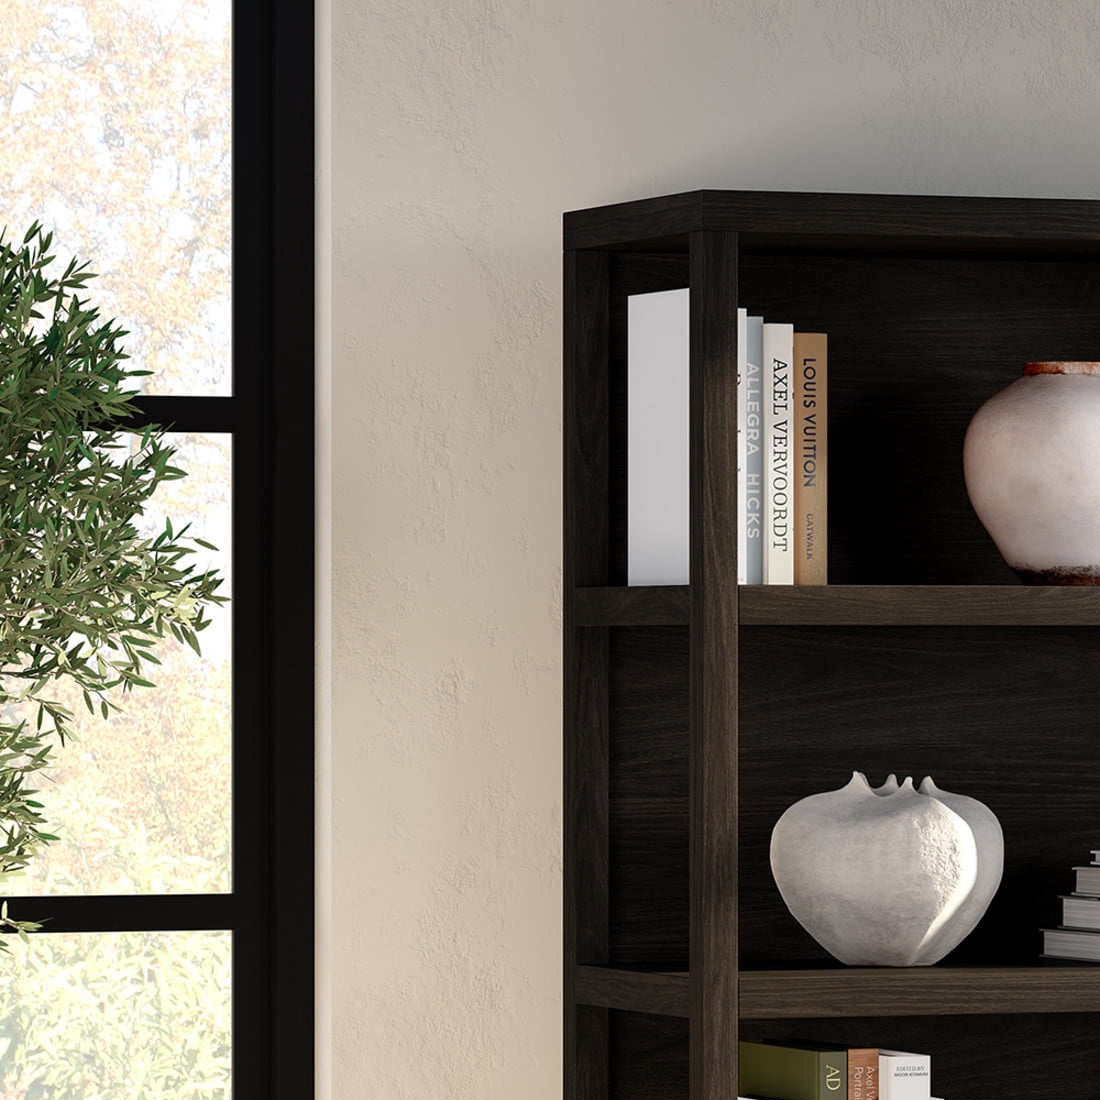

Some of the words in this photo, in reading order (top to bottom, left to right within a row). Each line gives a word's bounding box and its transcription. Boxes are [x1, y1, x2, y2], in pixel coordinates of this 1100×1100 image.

[747, 362, 760, 456] ALLEGRA
[773, 358, 788, 416] AXEL
[803, 358, 816, 408] LOUIS
[803, 413, 816, 487] VUITTON
[747, 473, 760, 539] HICKS
[773, 420, 788, 551] VERVOORDT
[825, 1064, 840, 1091] AD
[866, 1066, 875, 1088] Axel
